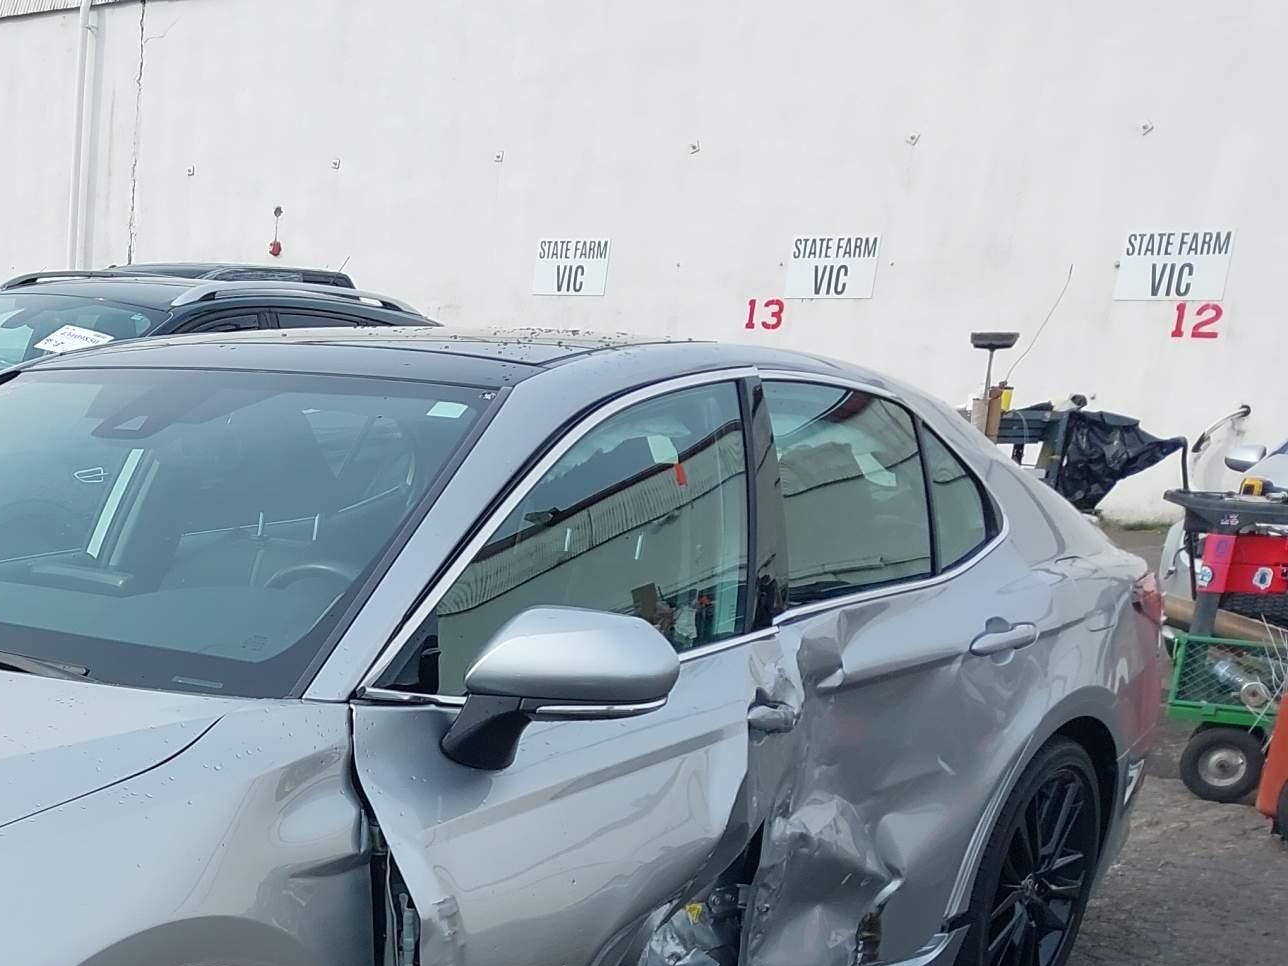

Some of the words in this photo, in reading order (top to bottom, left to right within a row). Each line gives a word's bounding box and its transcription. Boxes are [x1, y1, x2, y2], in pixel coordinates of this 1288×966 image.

[539, 240, 572, 259] STATE
[573, 240, 608, 260] FARM
[792, 238, 833, 259] STATE
[835, 237, 878, 258] FARM
[1126, 232, 1175, 256] STATE
[1178, 231, 1232, 256] FARM
[556, 264, 585, 293] VIC
[813, 264, 849, 296] VIC
[1150, 262, 1194, 297] VIC
[745, 298, 785, 330] 13
[1170, 302, 1223, 339] 12
